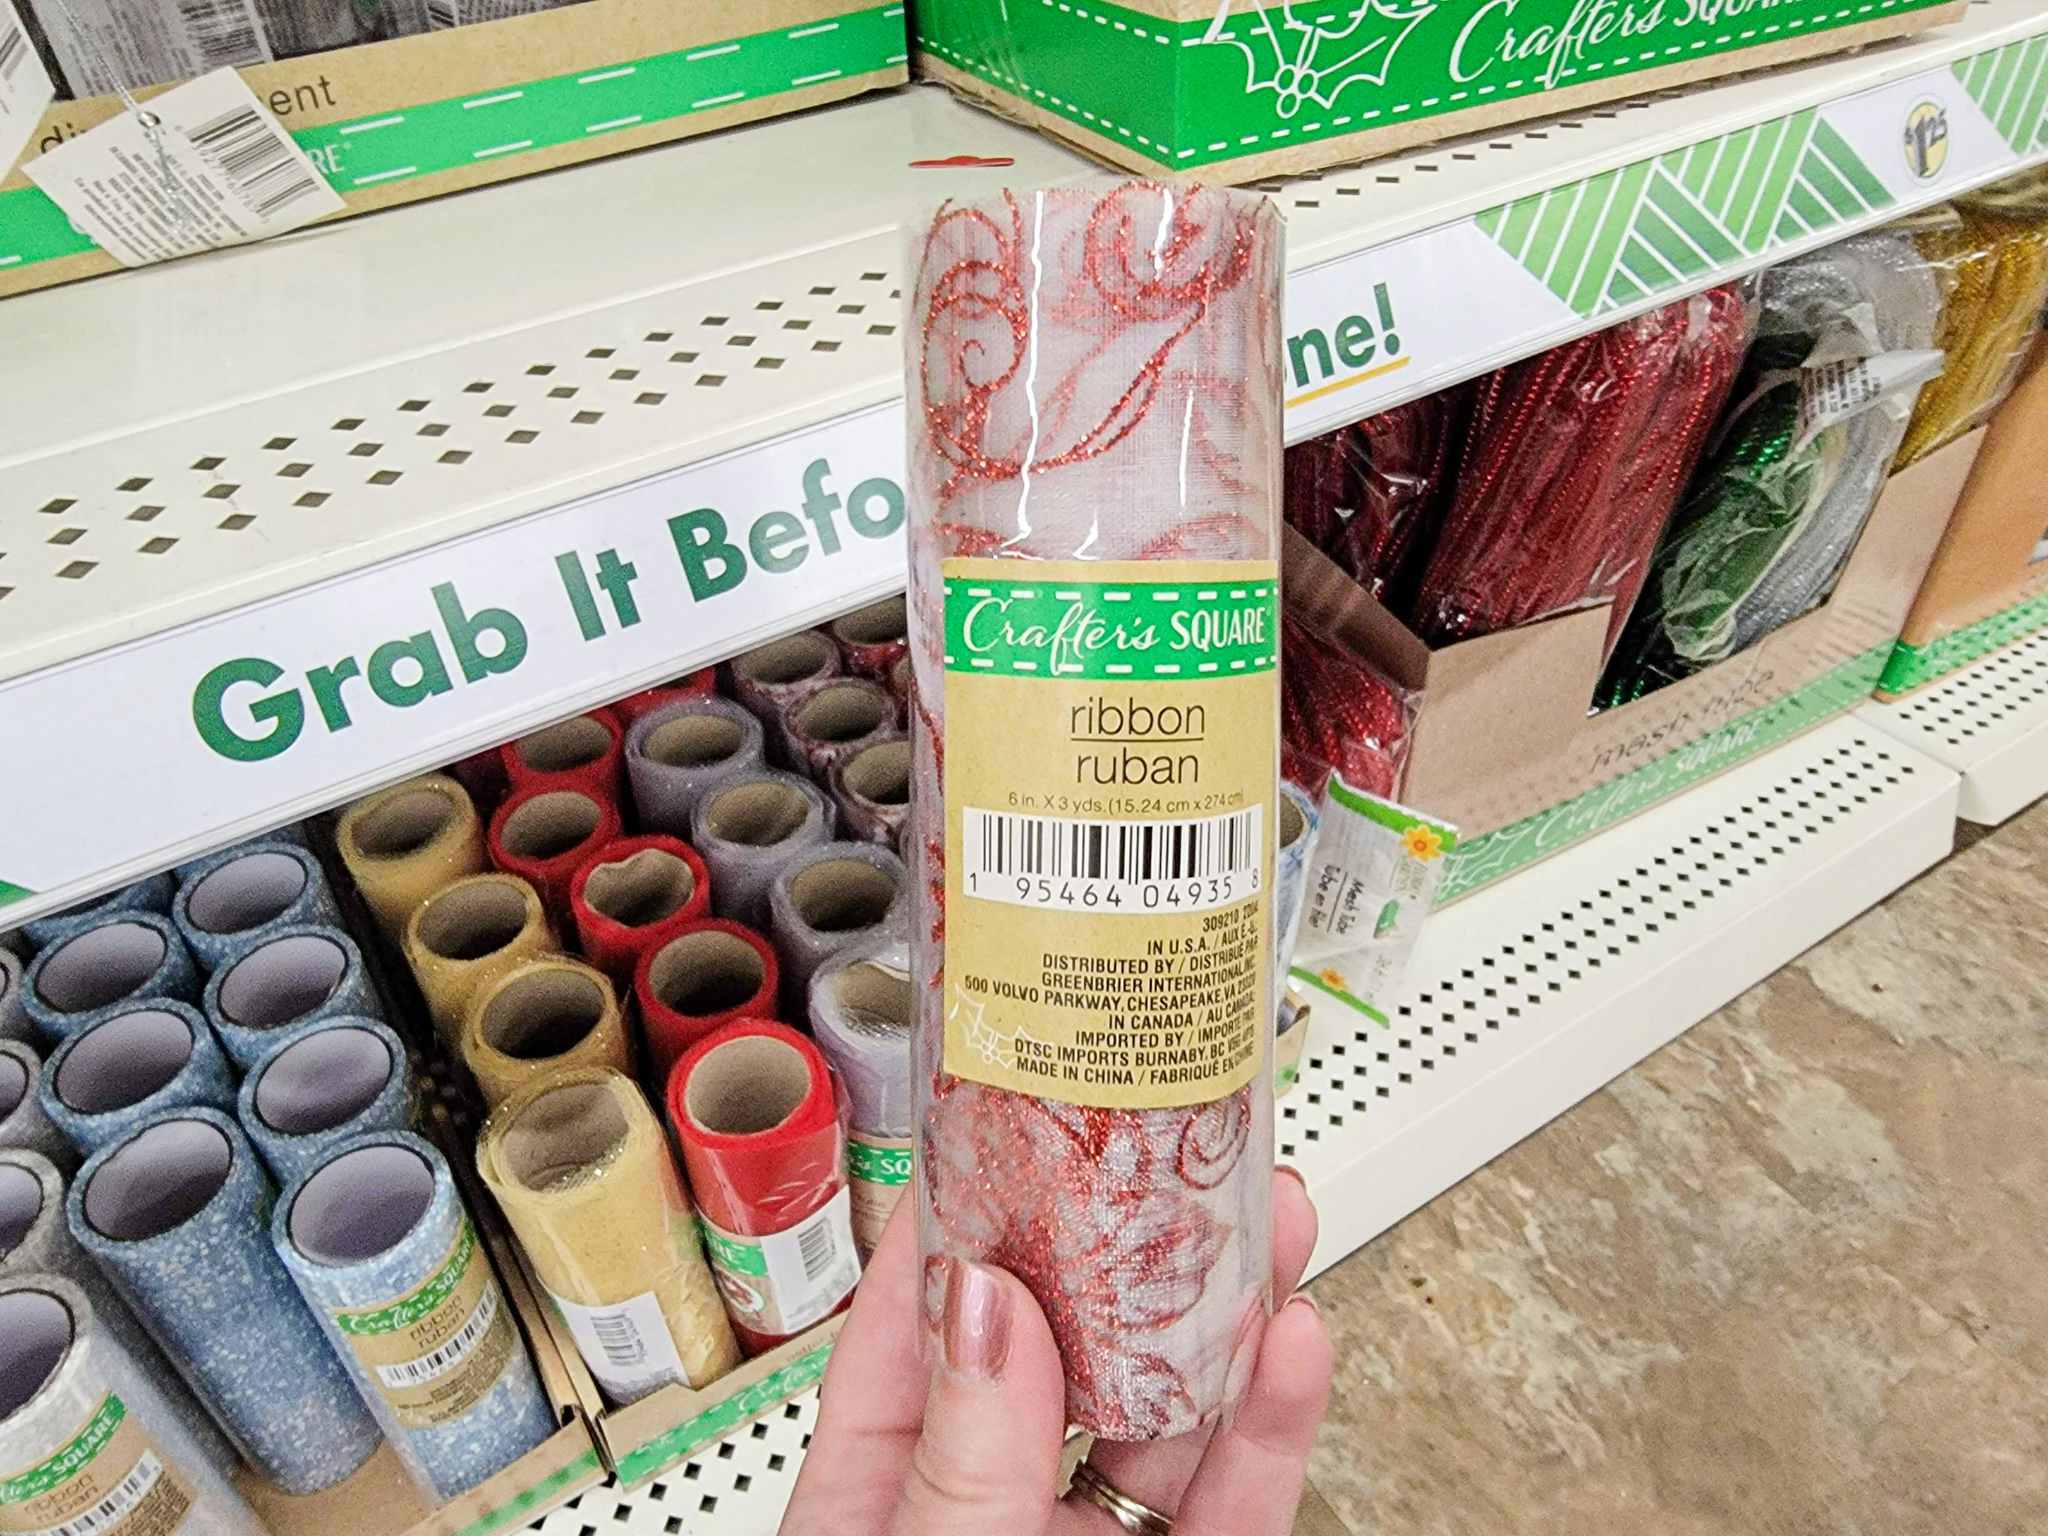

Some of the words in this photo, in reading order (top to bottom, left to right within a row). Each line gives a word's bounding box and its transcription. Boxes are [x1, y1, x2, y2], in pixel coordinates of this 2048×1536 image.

[258, 76, 336, 118] ent
[192, 581, 528, 762] Grab
[555, 548, 641, 642] It
[1284, 281, 1400, 388] ne!
[963, 598, 1161, 676] Crafter's
[1169, 607, 1266, 652] SQUARE
[1071, 697, 1205, 735] ribbon
[1077, 747, 1199, 784] ruban
[1008, 791, 1018, 806] 6
[1044, 795, 1057, 809] X
[1059, 796, 1069, 810] 3
[1166, 798, 1190, 813] cm
[969, 873, 977, 892] 1
[1016, 877, 1122, 908] 95464
[1143, 876, 1232, 908] 04935
[1250, 868, 1259, 889] 8
[1147, 940, 1163, 956] IN
[1169, 938, 1210, 955] U.S.A.
[1222, 928, 1239, 947] AUX
[1043, 953, 1148, 974] DISTRIBUTED
[1155, 958, 1175, 973] BY
[993, 981, 1039, 1003] VOLVO
[1042, 972, 1143, 993] GREENBRIER
[1108, 1015, 1124, 1030] IN
[1131, 1012, 1193, 1029] CANADA
[1206, 1008, 1223, 1024] AU
[1015, 1038, 1053, 1058] DTSC
[1057, 1046, 1129, 1066] IMPORTS
[1210, 1042, 1225, 1059] BC
[1076, 1030, 1158, 1048] IMPORTED
[1165, 1031, 1184, 1047] BY
[1016, 1058, 1058, 1078] MADE
[1063, 1066, 1078, 1080] IN
[1084, 1068, 1134, 1085] CHINA
[1150, 1064, 1219, 1084] FABRIQUÉ
